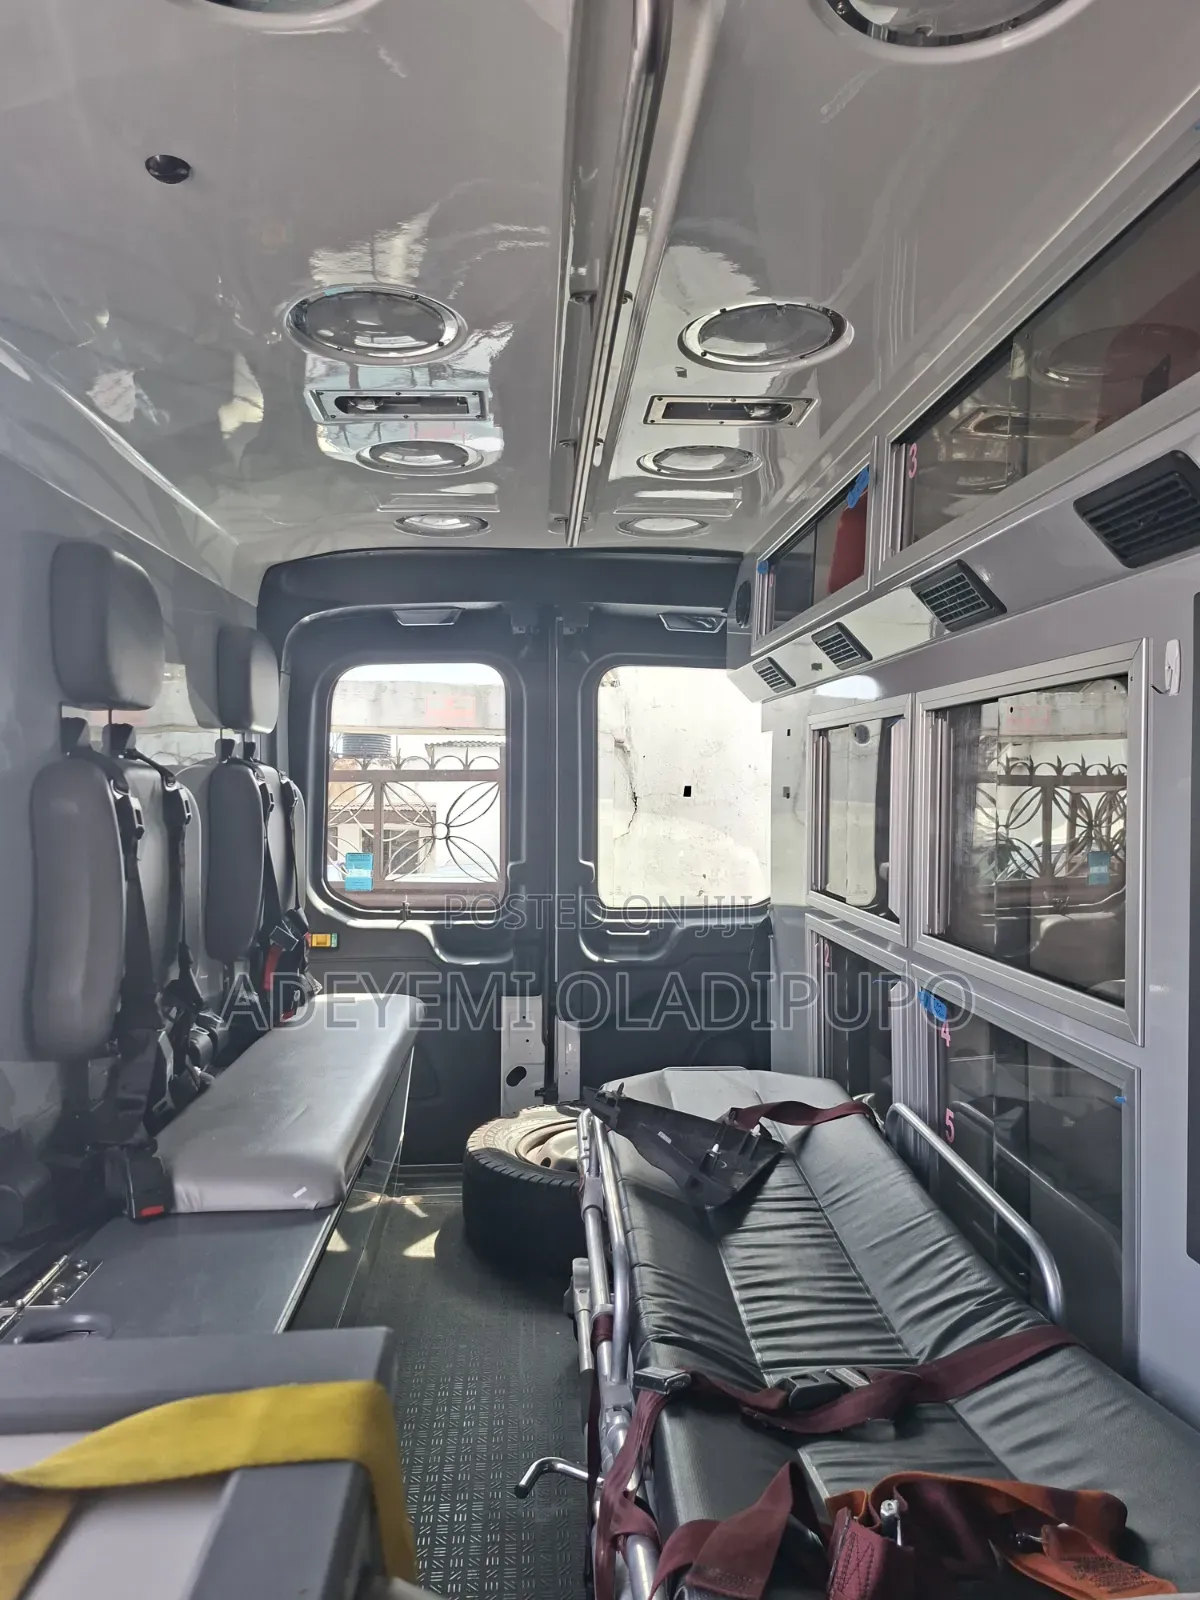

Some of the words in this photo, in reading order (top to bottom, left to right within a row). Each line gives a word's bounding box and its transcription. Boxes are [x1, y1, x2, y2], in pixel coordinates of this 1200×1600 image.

[908, 442, 918, 479] 3
[824, 943, 830, 968] 2
[940, 1022, 951, 1048] 4
[945, 1107, 955, 1143] 5
